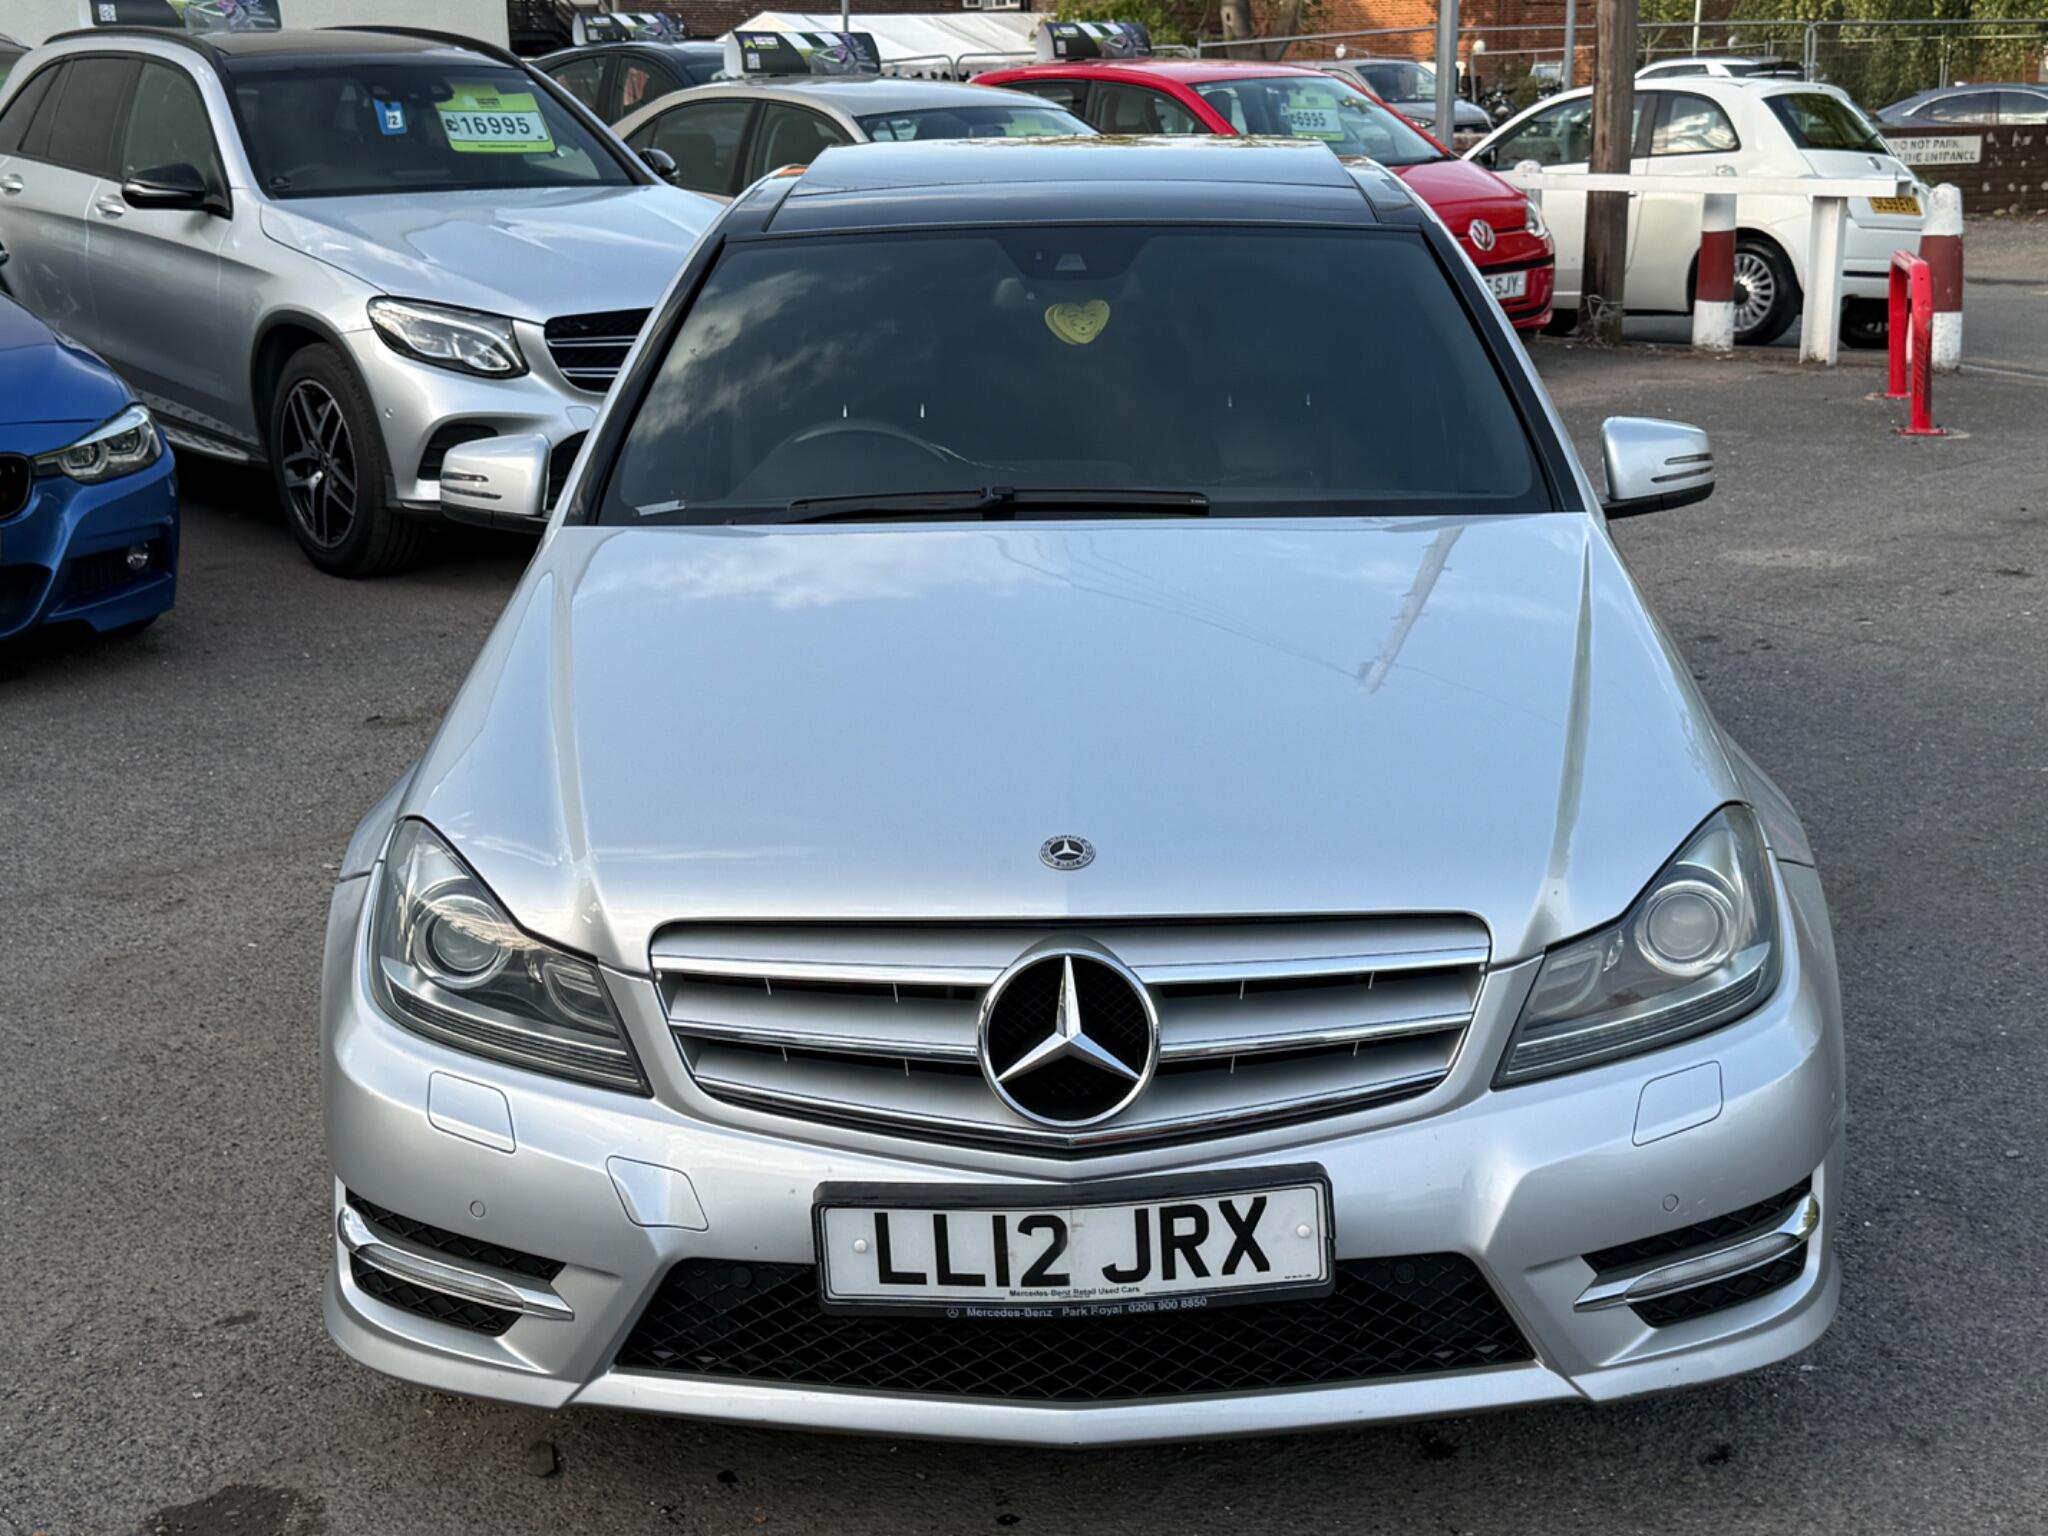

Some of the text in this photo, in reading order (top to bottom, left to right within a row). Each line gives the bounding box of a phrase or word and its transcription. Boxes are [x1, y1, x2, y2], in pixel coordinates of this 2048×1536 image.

[1910, 139, 1931, 150] NOT
[1933, 139, 1960, 149] PARK
[1925, 150, 1976, 162] ENTRANCE
[1495, 274, 1519, 295] SJY
[873, 1195, 1271, 1288] LL12 JRX
[1009, 1288, 1071, 1297] Mercedes-Benz
[1073, 1287, 1097, 1297] Retail
[1098, 1287, 1120, 1295] Used
[1121, 1285, 1140, 1294] Cars
[966, 1307, 1053, 1318] Mercedes-Benz
[1062, 1306, 1088, 1317] Park
